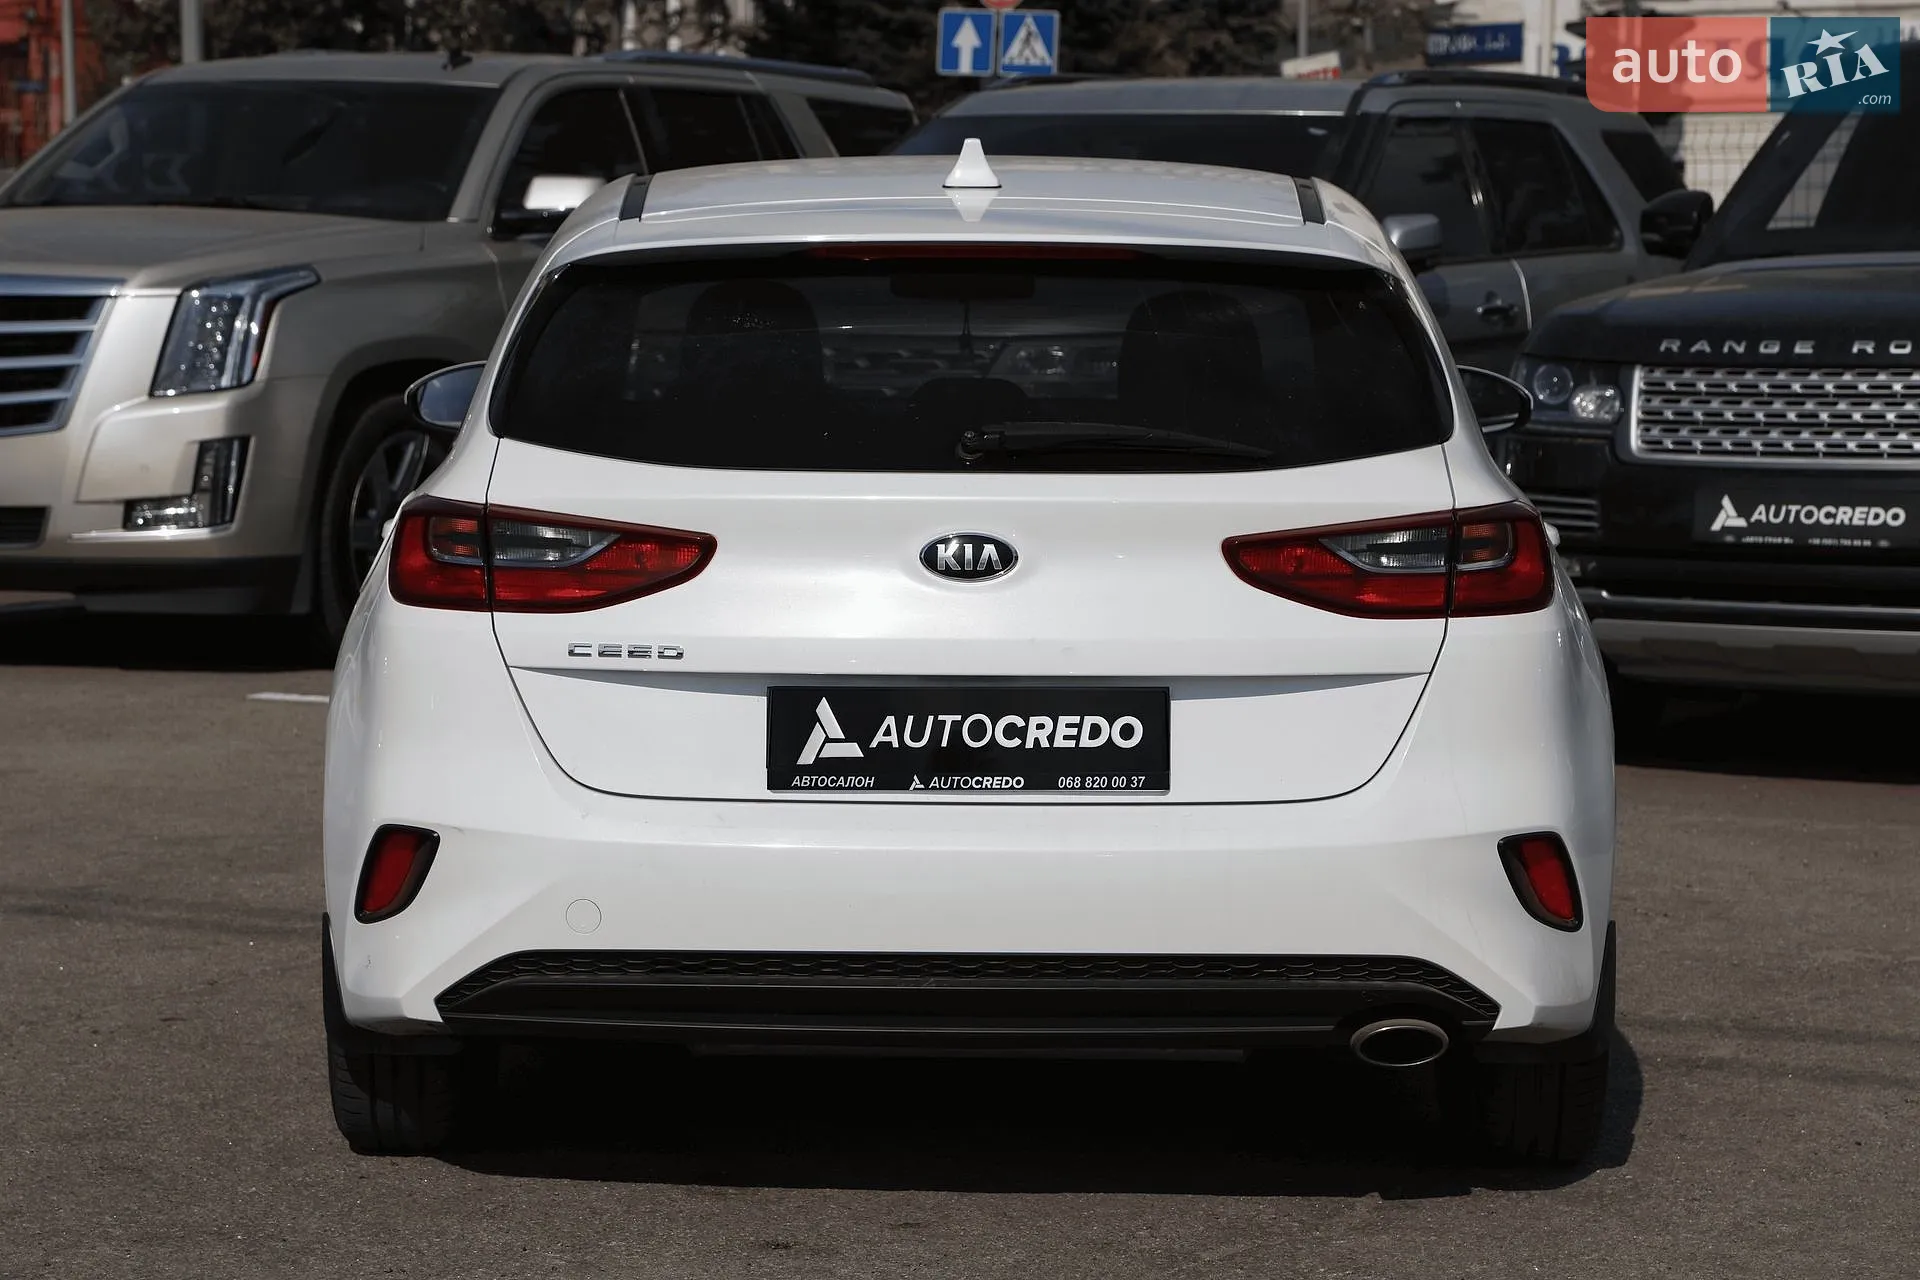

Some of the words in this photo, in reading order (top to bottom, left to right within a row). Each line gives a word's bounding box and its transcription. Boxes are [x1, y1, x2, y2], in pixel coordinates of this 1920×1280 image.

[1659, 339, 1815, 354] RANGE
[1750, 504, 1906, 527] AUTOCREDO
[936, 541, 1003, 571] KIA
[568, 643, 684, 660] CEED
[869, 714, 1144, 749] AUTOCREDO
[791, 775, 875, 788] АВТОСАЛОН
[929, 776, 1025, 789] AUTOCREDO
[1058, 775, 1082, 788] 068
[1085, 775, 1109, 788] 820
[1111, 775, 1128, 788] 00
[1130, 775, 1146, 788] 37
